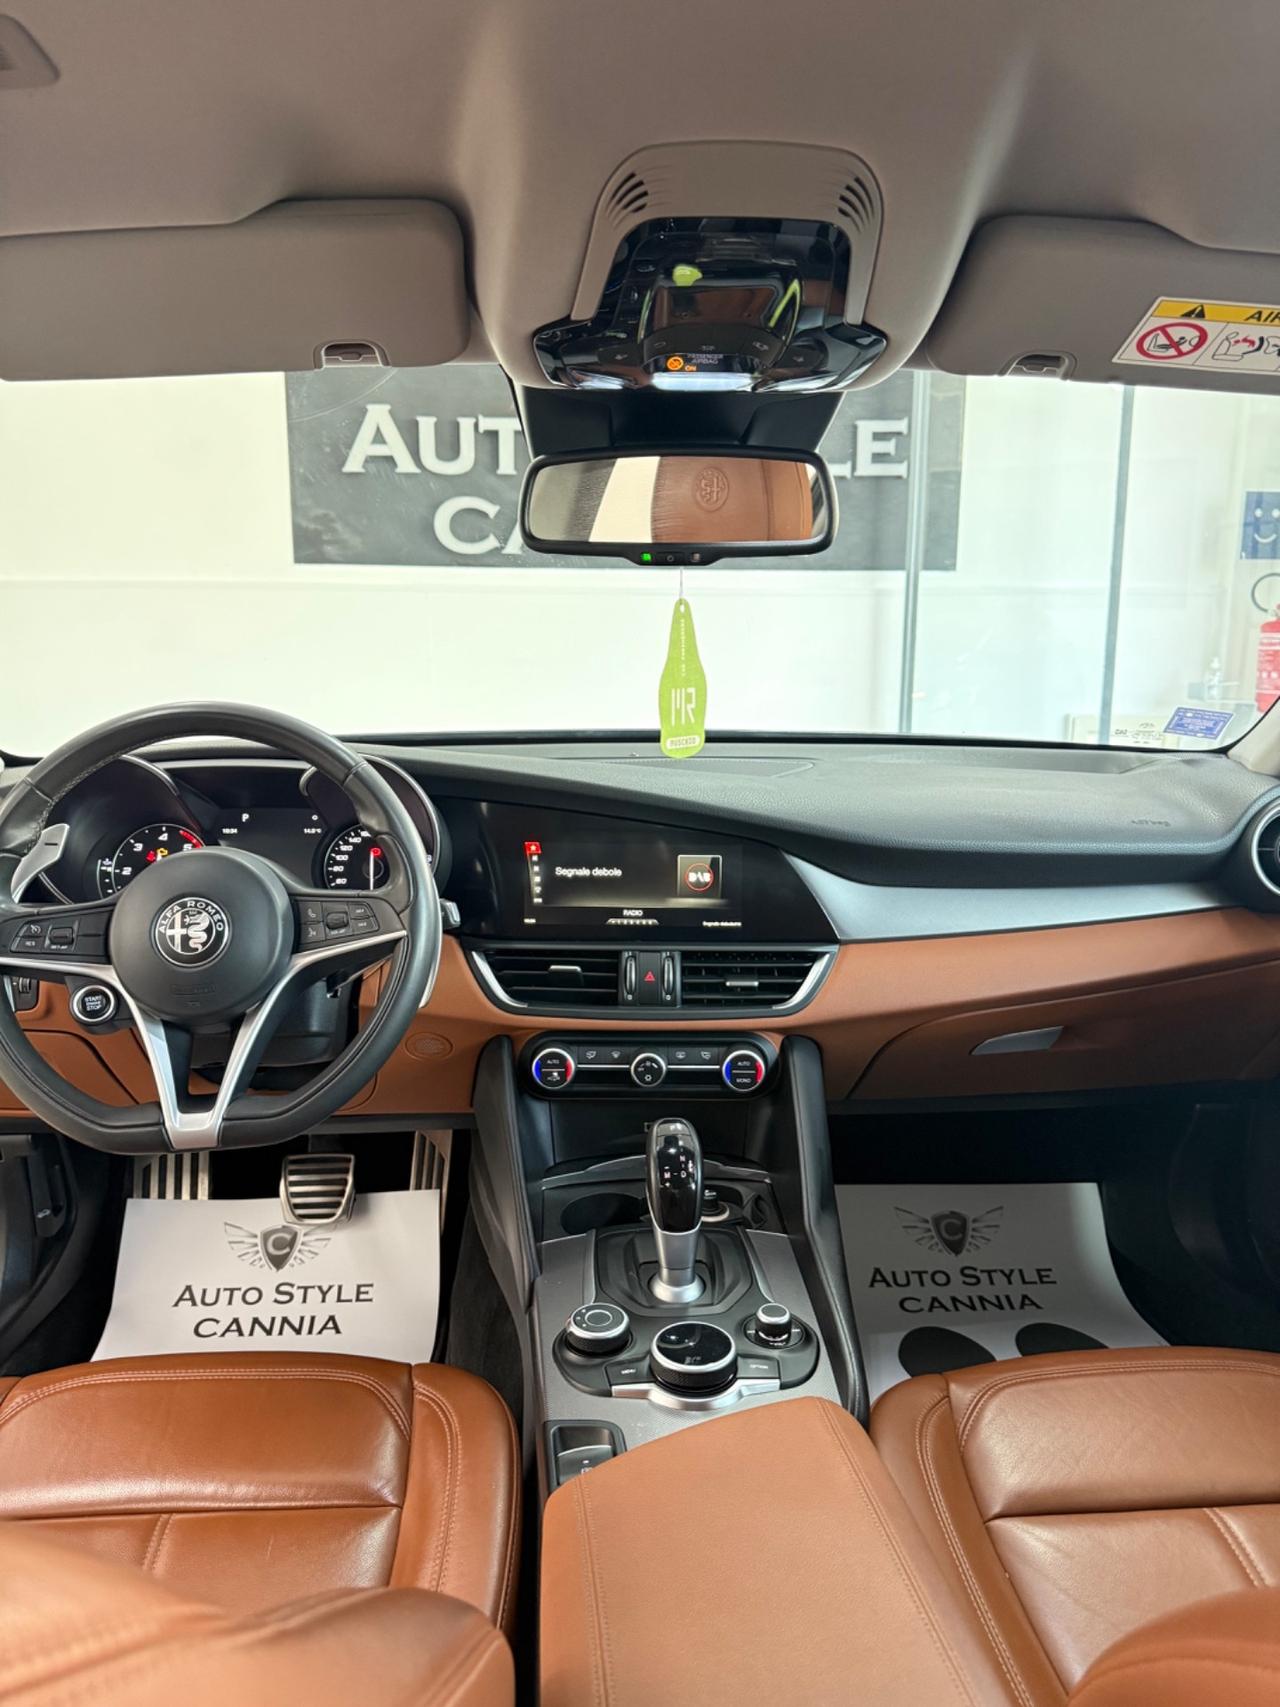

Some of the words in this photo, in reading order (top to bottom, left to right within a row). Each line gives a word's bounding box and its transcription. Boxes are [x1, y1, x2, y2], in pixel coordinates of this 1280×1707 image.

[241, 813, 249, 822] P
[158, 833, 168, 841] 4
[133, 842, 143, 852] 3
[183, 843, 193, 851] 5
[122, 866, 132, 876] 2
[555, 867, 591, 877] Segnale
[592, 867, 622, 876] debole
[159, 904, 182, 934] ALFA
[187, 900, 224, 932] ROMEO
[623, 909, 643, 917] RADIO
[664, 1171, 671, 1179] M
[868, 1266, 951, 1289] AUTO
[959, 1265, 1058, 1286] STYLE
[171, 1284, 263, 1308] AUTO
[273, 1281, 375, 1305] STYLE
[898, 1293, 1044, 1314] CANNIA
[193, 1314, 342, 1339] CANNIA
